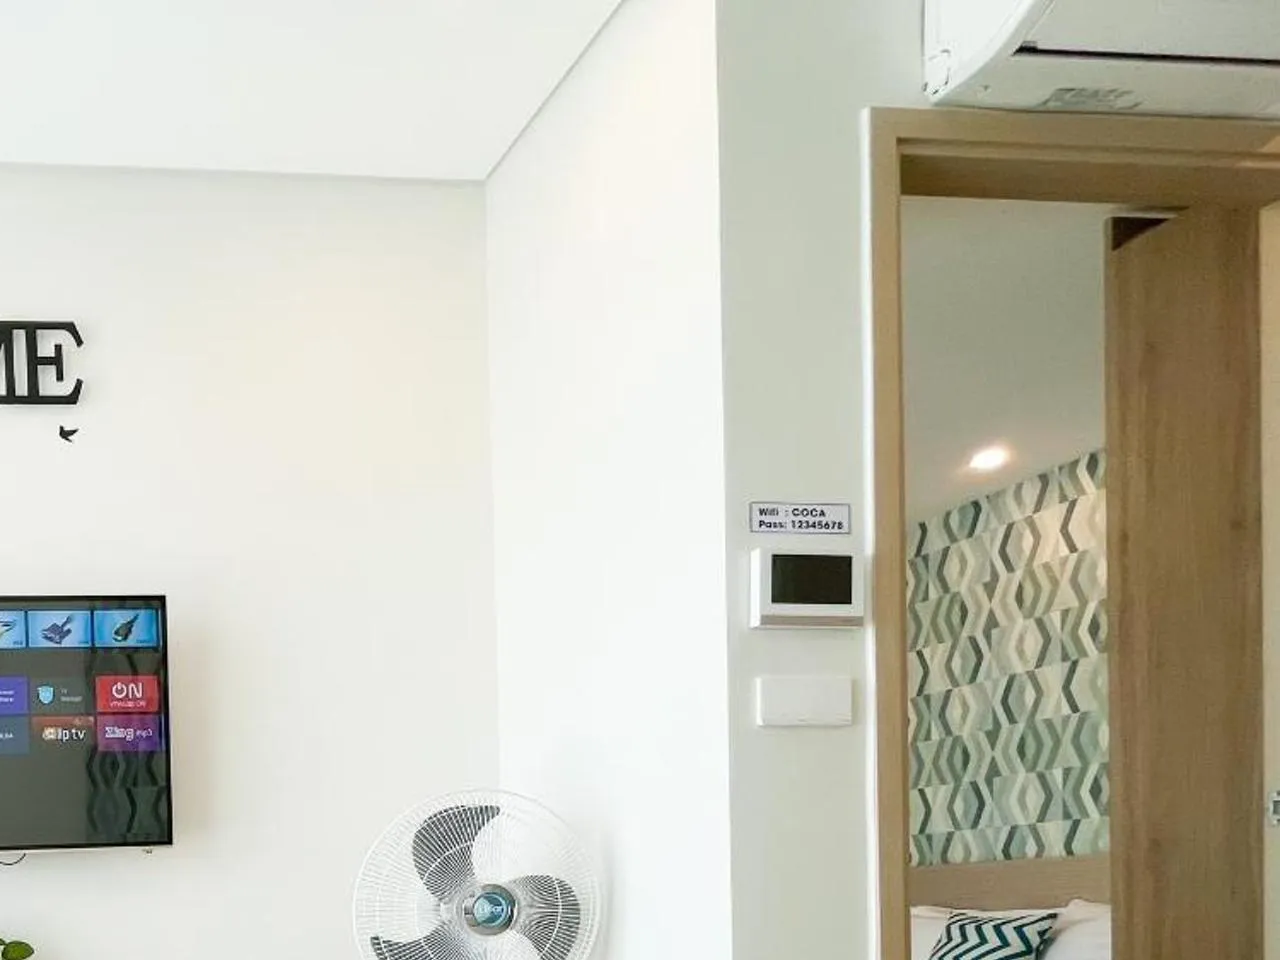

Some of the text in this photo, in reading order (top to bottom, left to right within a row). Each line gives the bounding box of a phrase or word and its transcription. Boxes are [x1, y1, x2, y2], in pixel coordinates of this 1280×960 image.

[791, 507, 826, 518] COCA
[759, 520, 844, 530] Pass: 12345678
